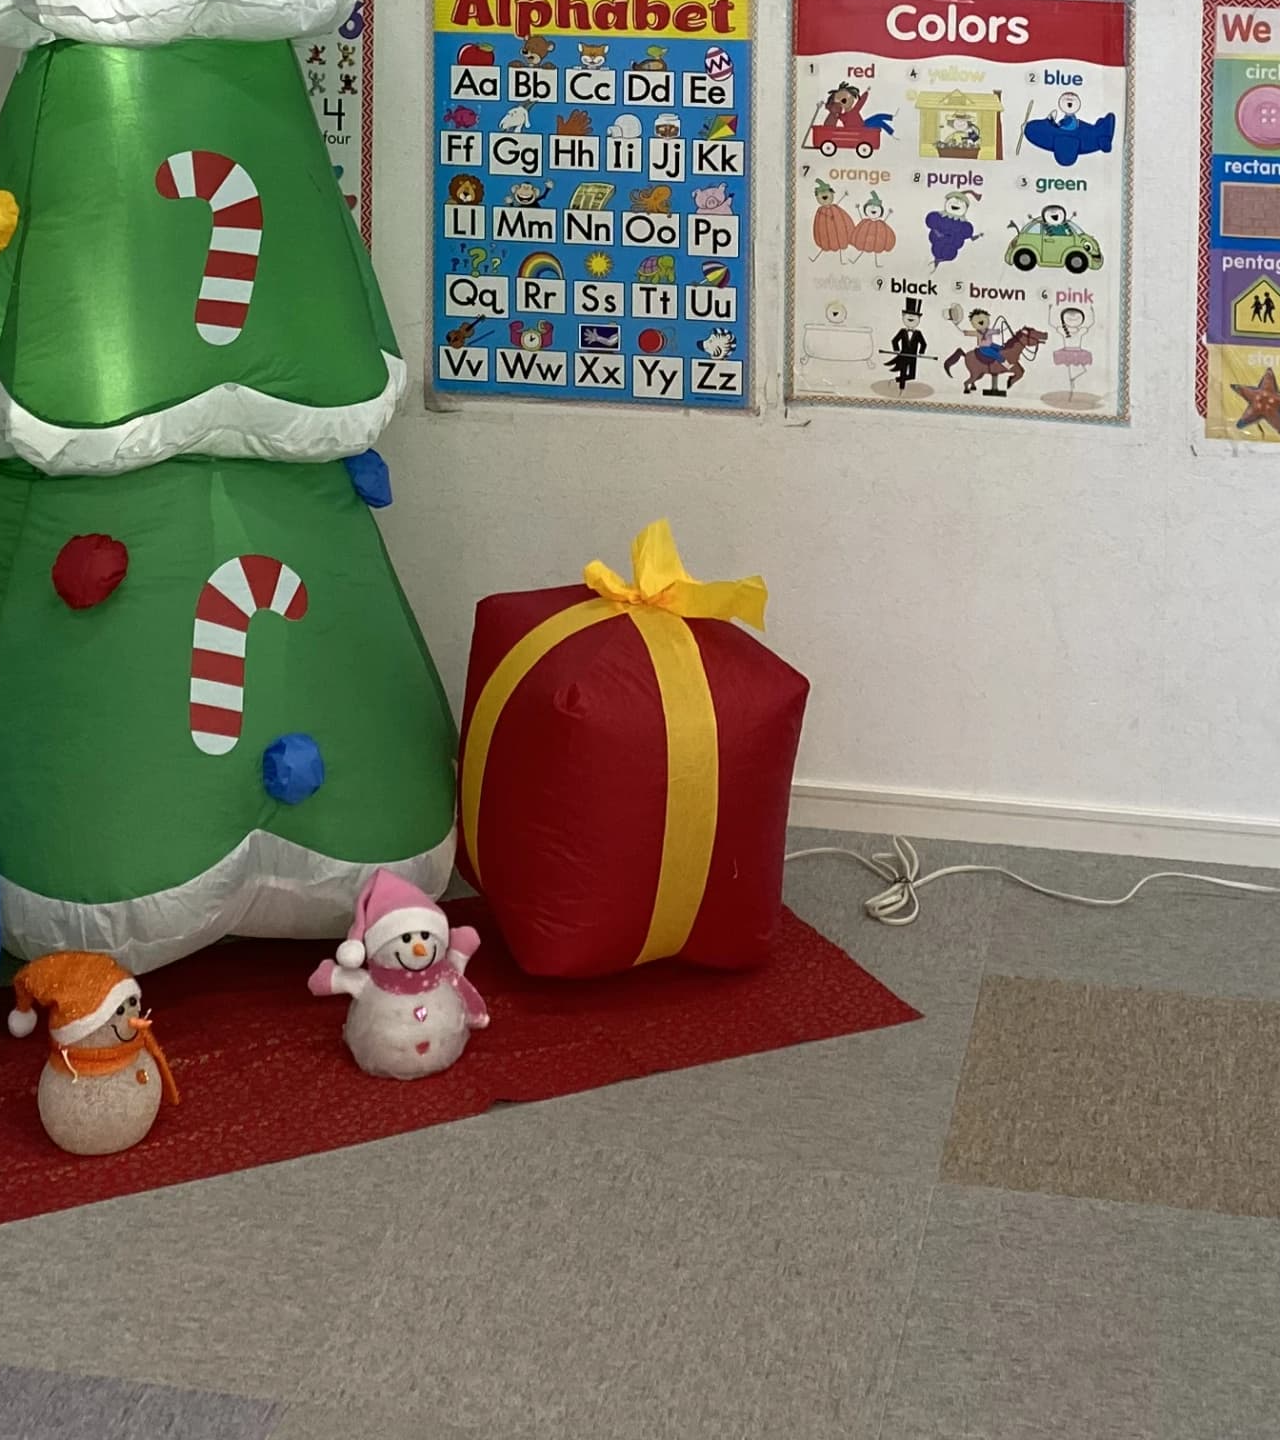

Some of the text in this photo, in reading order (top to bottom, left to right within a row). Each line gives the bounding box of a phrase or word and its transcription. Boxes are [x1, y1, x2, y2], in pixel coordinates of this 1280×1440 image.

[886, 3, 1030, 45] Colors
[1221, 14, 1271, 43] We
[453, 72, 498, 98] Aa
[513, 71, 552, 99] Bb
[847, 63, 875, 80] red
[928, 68, 986, 85] yellow
[1043, 69, 1084, 87] blue
[569, 73, 611, 100] Cc
[628, 74, 671, 102] Dd
[323, 98, 346, 131] 4
[323, 131, 352, 145] four
[446, 135, 475, 162] Ff
[492, 138, 539, 171] Gg
[554, 140, 595, 167] Hh
[697, 146, 738, 173] Kk
[829, 168, 891, 185] orange
[926, 171, 984, 188] purple
[1035, 176, 1088, 194] green
[496, 210, 553, 239] Mm
[567, 213, 611, 242] Nn
[693, 219, 732, 253] Pp
[524, 282, 557, 309] Rr
[890, 278, 938, 296] black
[969, 283, 1026, 301] brown
[1055, 288, 1094, 306] pink
